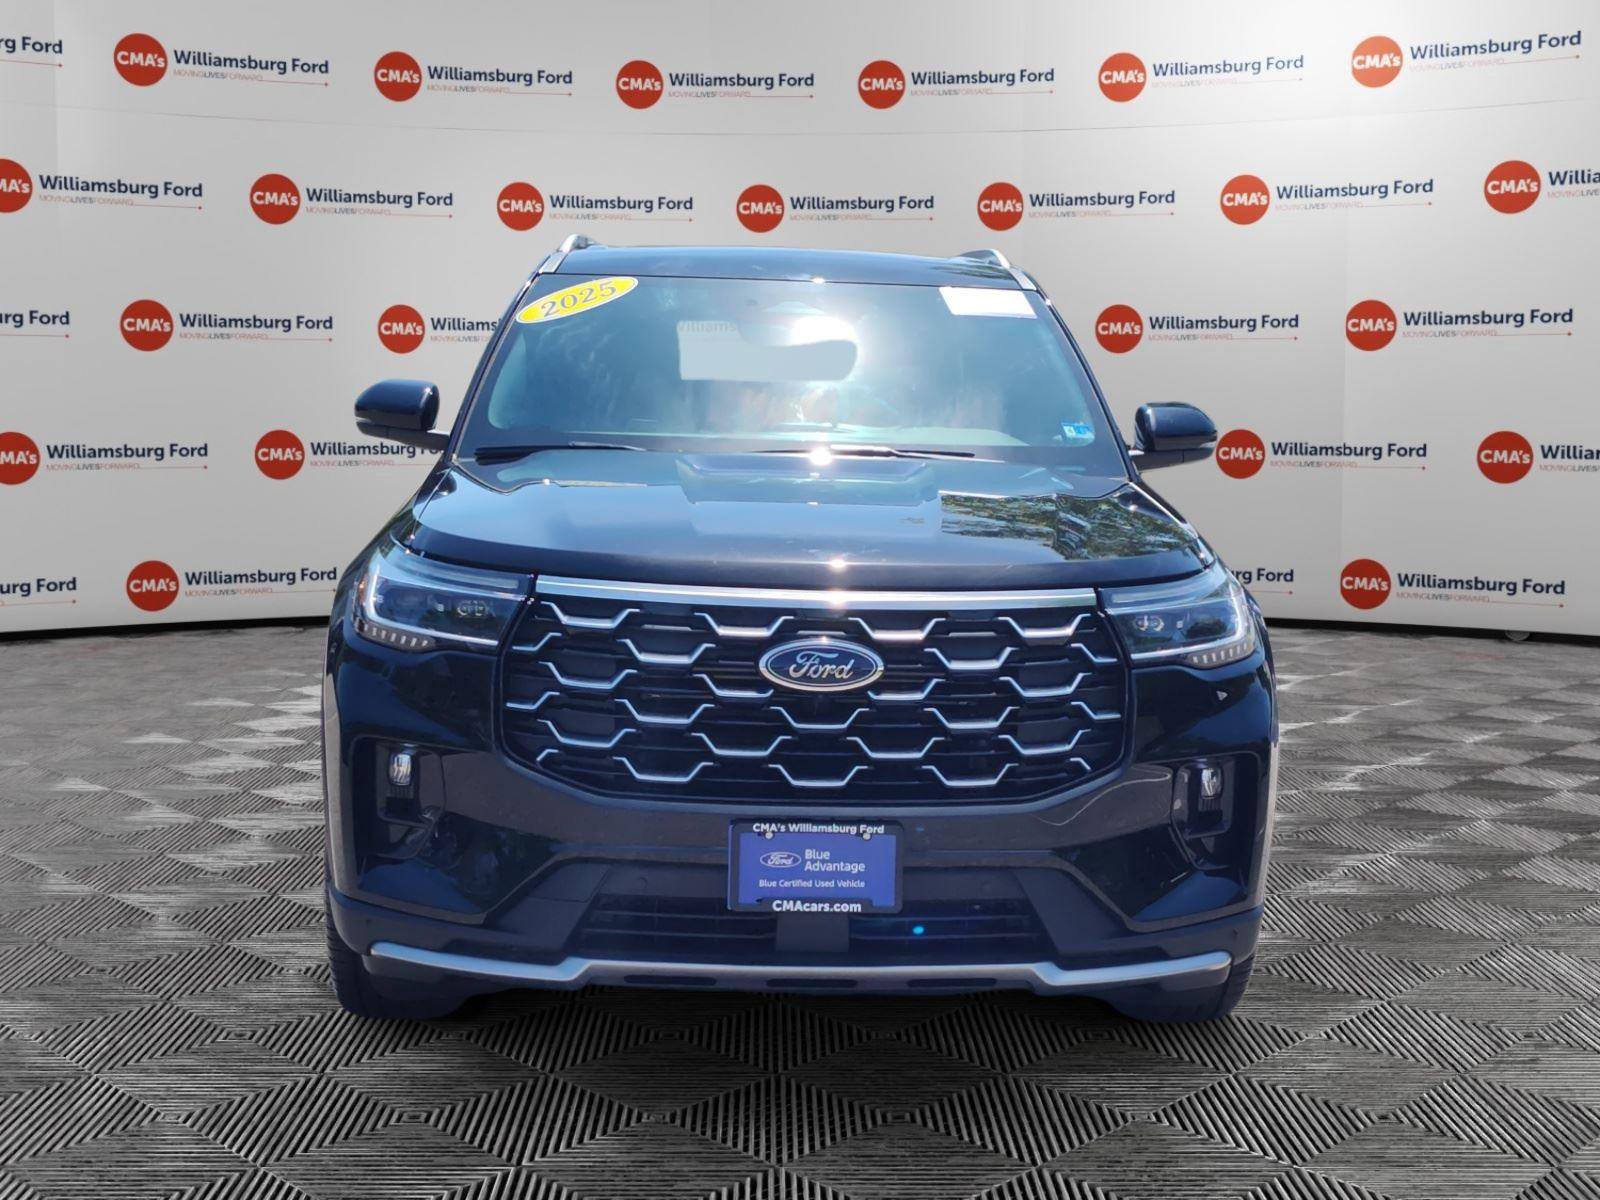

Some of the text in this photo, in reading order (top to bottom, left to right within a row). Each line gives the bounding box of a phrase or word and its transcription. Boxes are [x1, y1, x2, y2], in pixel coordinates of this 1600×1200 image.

[22, 36, 62, 54] Ford
[1354, 31, 1581, 69] CMA's Williamsburg Ford
[117, 50, 328, 75] CMA's Williamsburg Ford
[1100, 56, 1303, 84] CMA's Williamsburg Ford
[377, 66, 572, 86] CMA's Williamsburg Ford
[619, 73, 814, 90] CMA's Williamsburg Ford
[861, 69, 1054, 90] CMA's Williamsburg Ford
[39, 175, 158, 199] Williamsburg
[164, 182, 202, 197] Ford
[1487, 170, 1600, 194] CMA's Willia
[253, 188, 452, 208] CMA's Williamsburg Ford
[980, 191, 1174, 212] CMA's Williamsburg Ford
[1222, 179, 1433, 206] CMA's Williamsburg Ford
[500, 195, 693, 213] CMA's Williamsburg Ford
[739, 196, 934, 214] CMA's Williamsburg Ford
[541, 281, 616, 317] 2025
[29, 310, 69, 325] Ford
[124, 314, 332, 332] CMA's Williamsburg Ford
[381, 317, 498, 335] CMA's Williams
[1098, 315, 1298, 334] CMA's Williamsburg Ford
[1349, 309, 1573, 331] CMA's Williamsburg Ford
[0, 443, 208, 464] MA's Williamsburg Ford
[258, 448, 302, 460] CMA's
[311, 442, 416, 458] Williamsburg
[1219, 442, 1426, 460] CMA's Williamsburg Ford
[1481, 445, 1600, 463] CMA's Willia
[130, 567, 336, 592] CMA's Williamsburg Ford
[1257, 568, 1294, 582] Ford
[37, 577, 76, 592] Ford
[1343, 573, 1565, 596] CMA's Williamsburg Ford
[789, 651, 855, 679] Ford
[752, 823, 885, 835] CMA's Williamsburg Ford
[767, 854, 794, 865] Ford
[804, 849, 830, 860] Blue
[804, 861, 866, 874] Advantage
[759, 879, 865, 888] Blue Certified Used Vehicle
[772, 900, 862, 912] CMAcars.com
